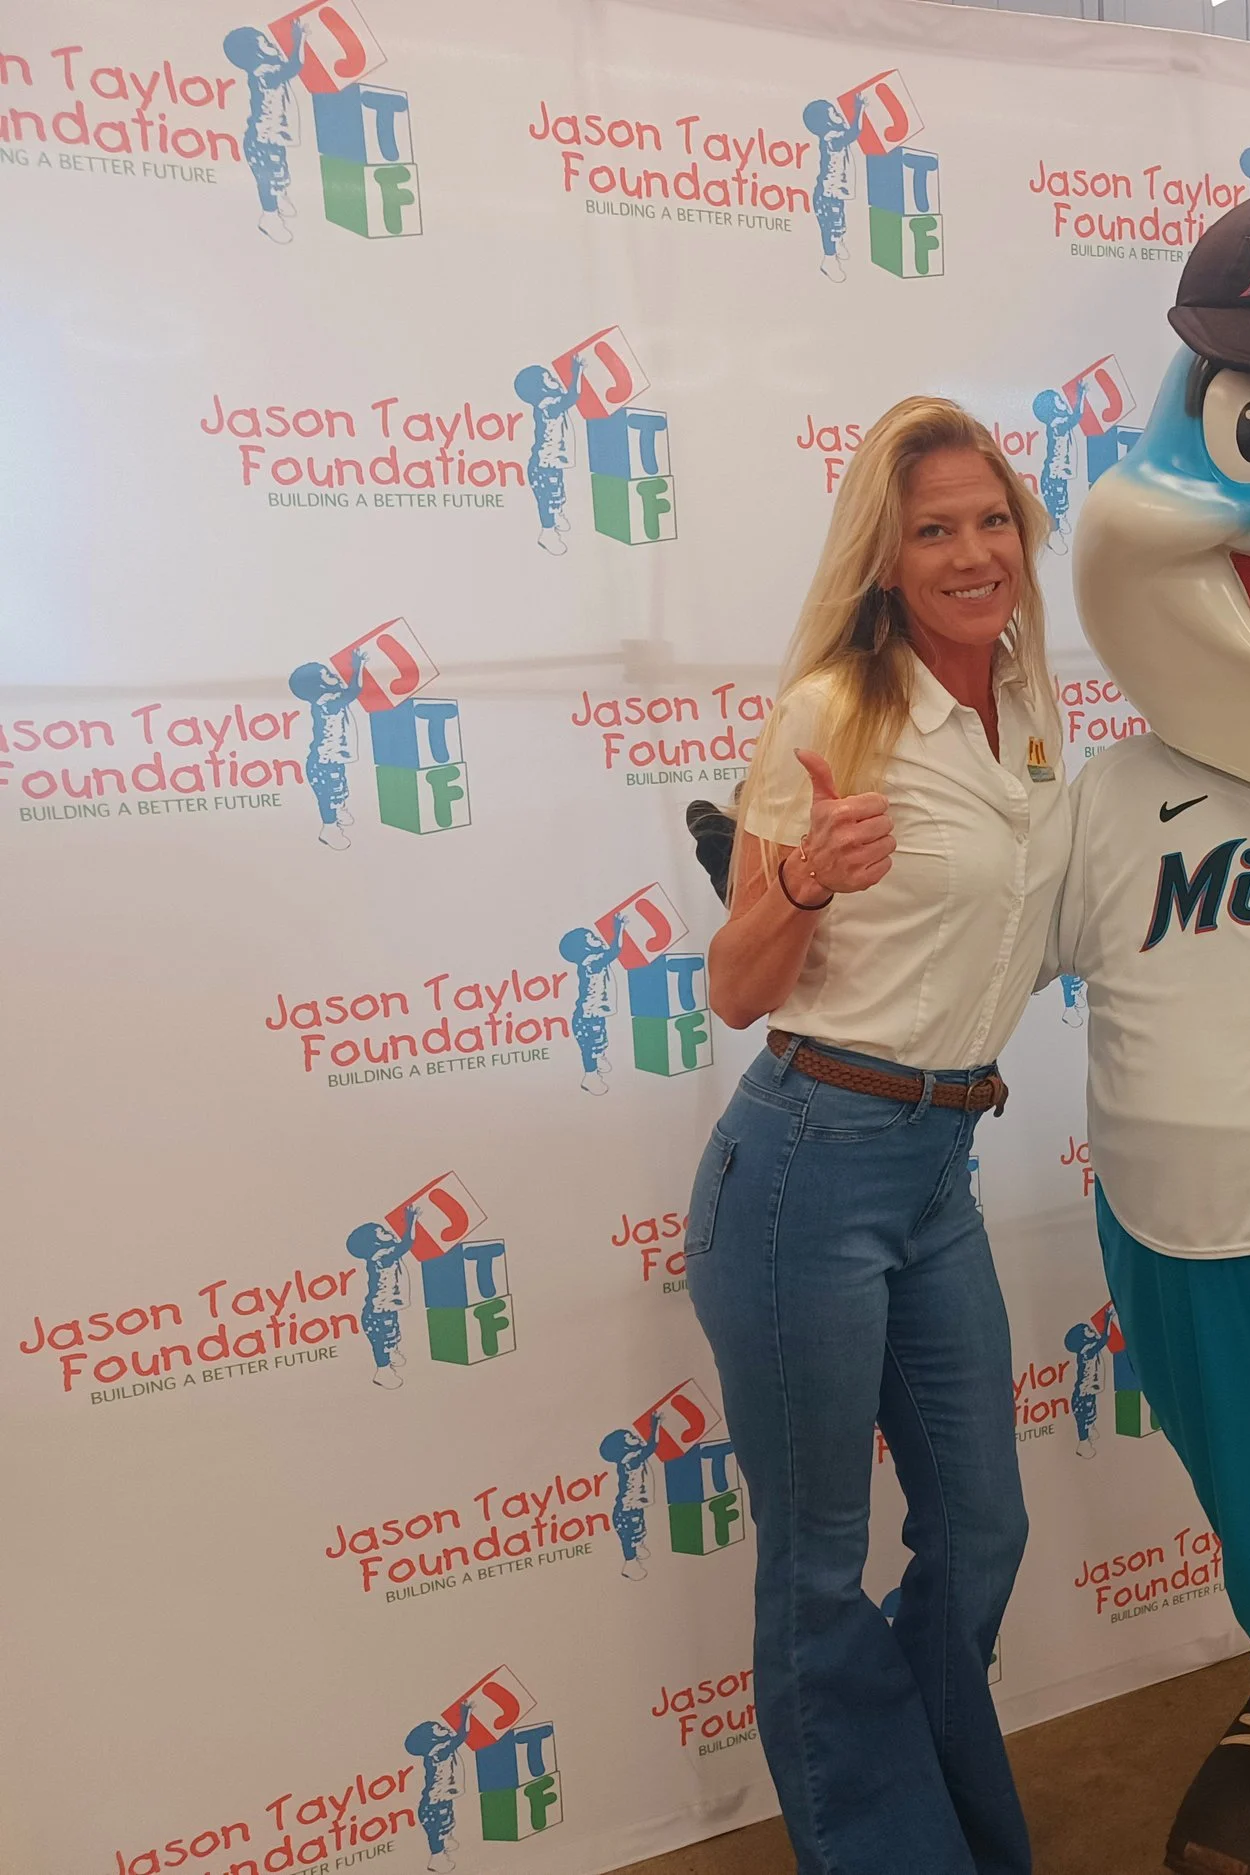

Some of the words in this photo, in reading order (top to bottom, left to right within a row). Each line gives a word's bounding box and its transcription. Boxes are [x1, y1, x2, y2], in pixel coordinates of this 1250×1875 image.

[318, 6, 366, 79] J
[50, 45, 236, 113] Taylor
[0, 100, 241, 162] ndation
[359, 89, 408, 161] T
[528, 100, 663, 152] Jason
[676, 117, 810, 172] Taylor
[875, 82, 909, 143] J
[36, 151, 52, 168] A
[58, 153, 137, 176] BETTER
[142, 161, 217, 184] FUTURE
[560, 150, 810, 213] Foundation
[902, 152, 938, 213] T
[1030, 159, 1132, 199] Jason
[1142, 166, 1246, 213] Taylor
[372, 163, 415, 235] F
[585, 198, 656, 219] BUILDING
[660, 206, 672, 220] A
[677, 207, 733, 226] BETTER
[737, 213, 792, 232] FUTURE
[1054, 201, 1206, 246] Foundati
[908, 213, 939, 275] F
[1070, 242, 1125, 259] BUILDING
[1128, 247, 1138, 260] A
[1141, 248, 1184, 263] BETTER
[594, 341, 633, 404] J
[200, 394, 356, 438] Jason
[371, 397, 524, 450] Taylor
[626, 413, 667, 476] T
[239, 445, 526, 489] Foundation
[268, 492, 349, 508] BUILDING
[355, 493, 368, 508] A
[374, 493, 438, 508] BETTER
[443, 493, 505, 508] FUTURE
[636, 477, 671, 540] F
[376, 633, 420, 696] J
[131, 703, 301, 754] Taylor
[413, 702, 457, 763] T
[571, 691, 699, 727] Jason
[20, 803, 110, 822] BUILDING
[117, 802, 132, 816] A
[137, 797, 208, 815] BETTER
[214, 793, 282, 811] FUTURE
[425, 764, 464, 827] F
[626, 769, 693, 786] BUILDING
[698, 769, 709, 782] A
[635, 897, 672, 953] J
[264, 992, 410, 1030] Jason
[424, 969, 568, 1016] Taylor
[665, 955, 704, 1011] T
[300, 1011, 570, 1072] Foundation
[327, 1066, 403, 1088] BUILDING
[409, 1064, 421, 1077] A
[426, 1055, 487, 1075] BETTER
[491, 1047, 550, 1067] FUTURE
[674, 1011, 708, 1069] F
[428, 1188, 469, 1243] J
[462, 1240, 504, 1298] T
[19, 1304, 183, 1353] Jason
[198, 1268, 357, 1319] Taylor
[472, 1297, 509, 1356] F
[59, 1312, 359, 1391] Foundation
[90, 1376, 176, 1405] BUILDING
[182, 1373, 196, 1386] A
[202, 1358, 269, 1383] BETTER
[274, 1345, 338, 1369] FUTURE
[670, 1394, 706, 1444] J
[699, 1439, 736, 1493] T
[325, 1509, 461, 1558] Jason
[474, 1470, 608, 1522] Taylor
[707, 1491, 739, 1546] F
[359, 1513, 611, 1592] Foundation
[386, 1575, 456, 1603] BUILDING
[461, 1572, 473, 1584] A
[477, 1557, 534, 1581] BETTER
[538, 1542, 592, 1566] FUTURE
[1074, 1547, 1164, 1587] Jason
[1096, 1553, 1221, 1614] Foundat
[1112, 1601, 1159, 1624] BUILDING
[1162, 1598, 1170, 1609] A
[1173, 1586, 1210, 1606] BETTER
[265, 1765, 414, 1831] Taylor
[336, 1840, 396, 1870] FUTURE
